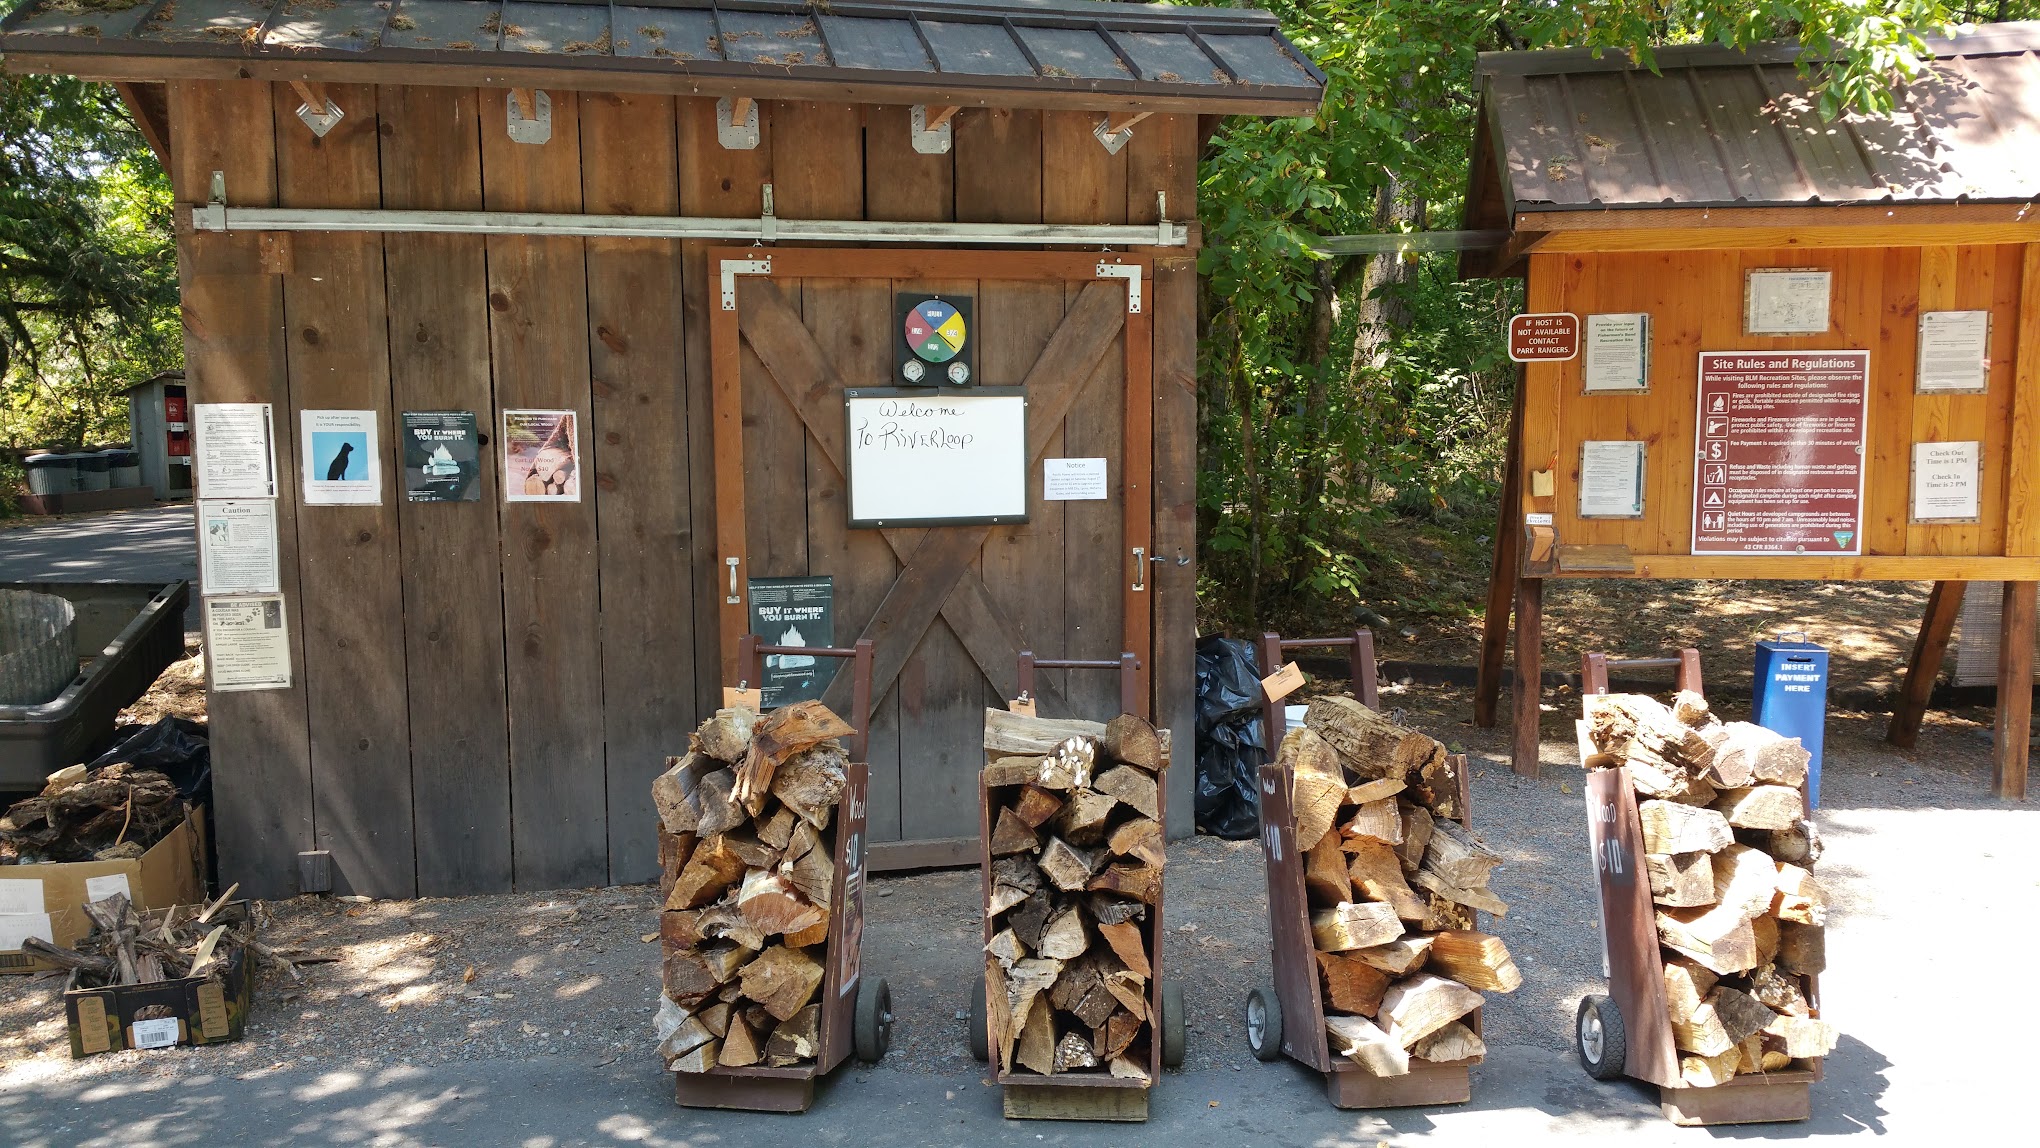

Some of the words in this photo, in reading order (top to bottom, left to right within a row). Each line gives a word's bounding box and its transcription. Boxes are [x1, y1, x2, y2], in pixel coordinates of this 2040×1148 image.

[1713, 359, 1733, 369] Site
[1737, 358, 1766, 369] Rules
[1768, 358, 1788, 368] and
[1792, 358, 1856, 370] Regulations
[879, 400, 966, 418] Welcome
[856, 417, 874, 450] To
[758, 607, 782, 615] BUY
[846, 832, 858, 870] $10
[1600, 839, 1622, 874] $10
